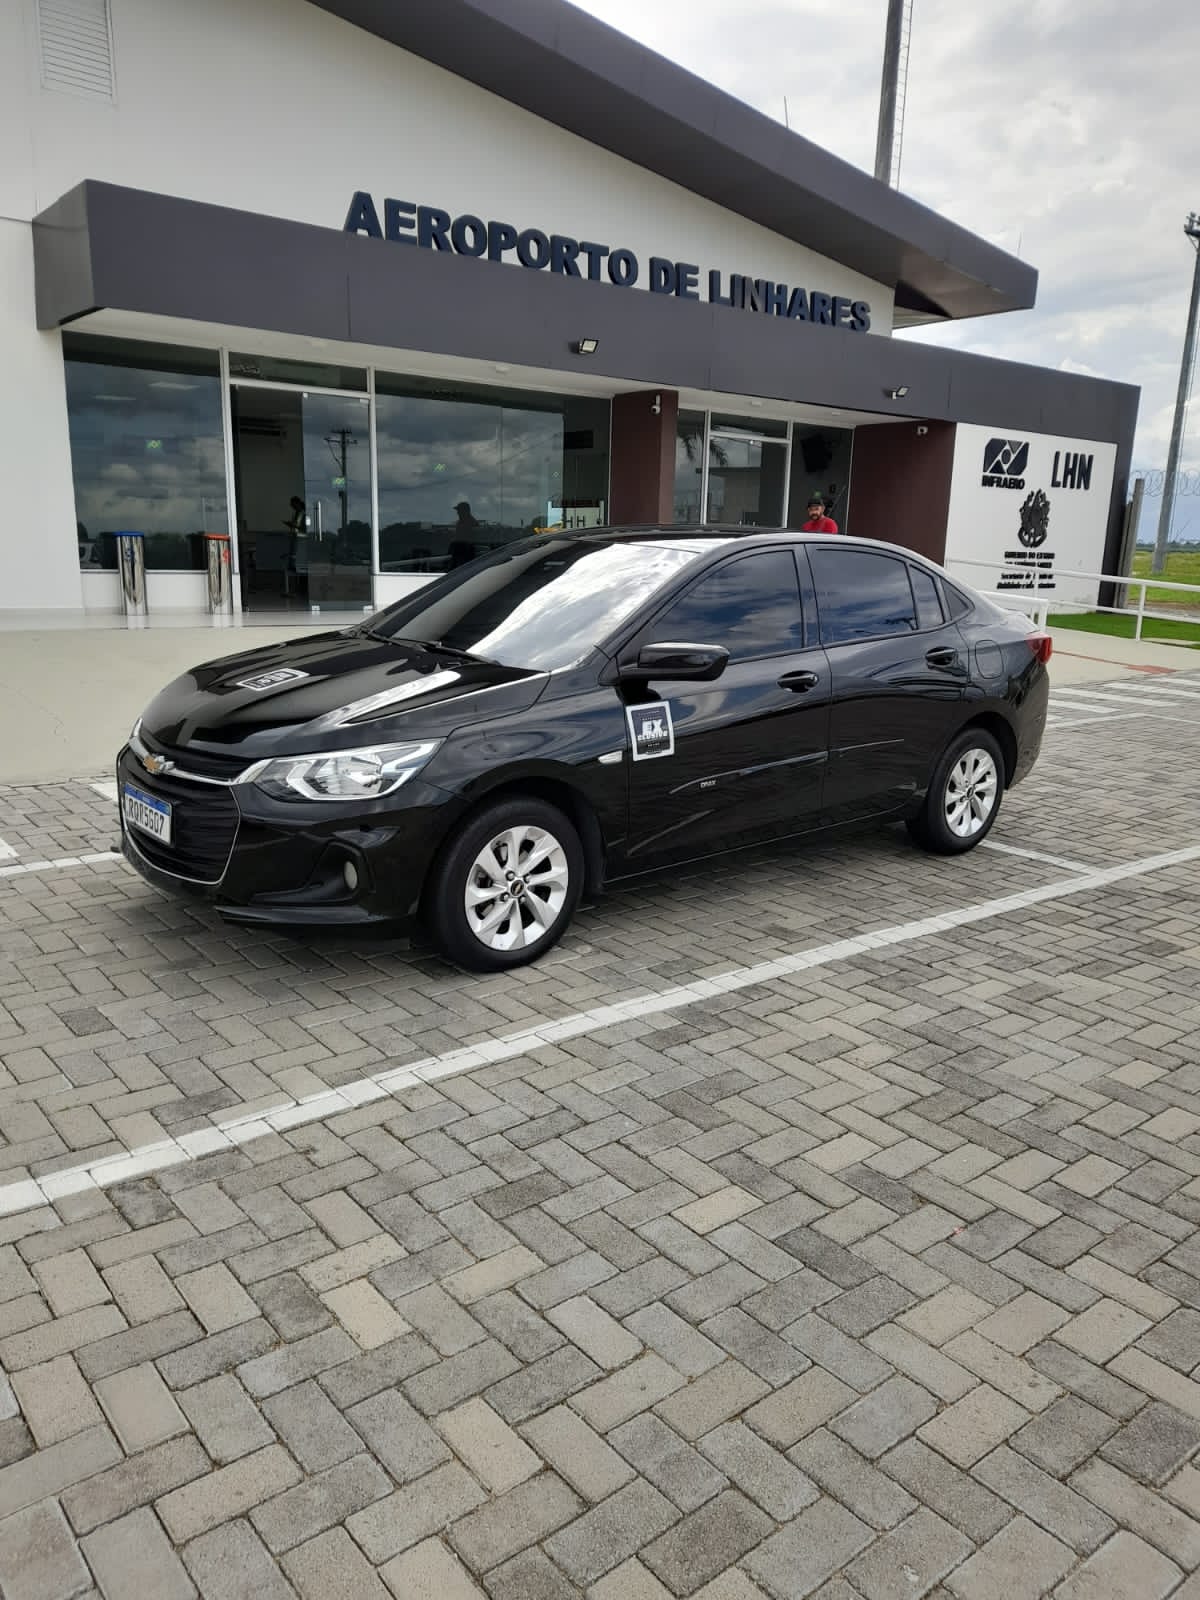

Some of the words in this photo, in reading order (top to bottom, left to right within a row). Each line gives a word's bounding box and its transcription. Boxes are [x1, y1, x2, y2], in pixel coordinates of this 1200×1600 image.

[344, 191, 639, 287] AEROPORTO
[649, 256, 699, 298] DE
[708, 269, 872, 333] LINHARES
[981, 475, 1025, 490] INFRAERO
[1051, 451, 1094, 490] LHN
